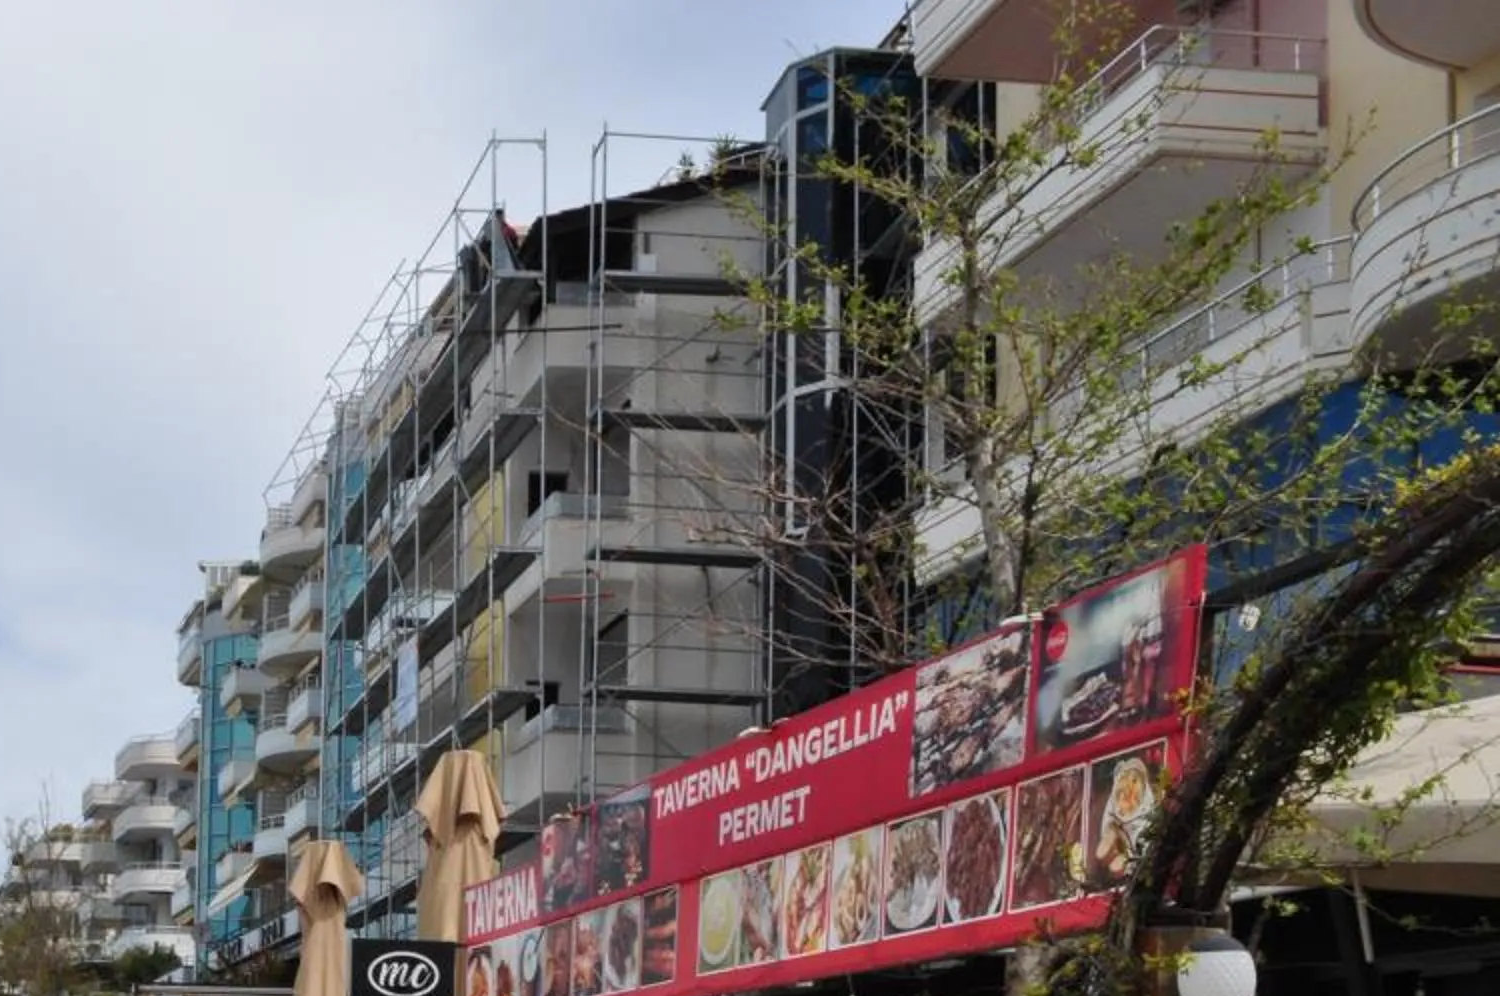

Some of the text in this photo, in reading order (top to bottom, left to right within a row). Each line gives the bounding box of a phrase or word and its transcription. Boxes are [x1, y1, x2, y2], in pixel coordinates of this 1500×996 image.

[653, 758, 741, 820] TAVERNA
[718, 785, 811, 847] PERMET
[465, 866, 538, 938] TAVERNA
